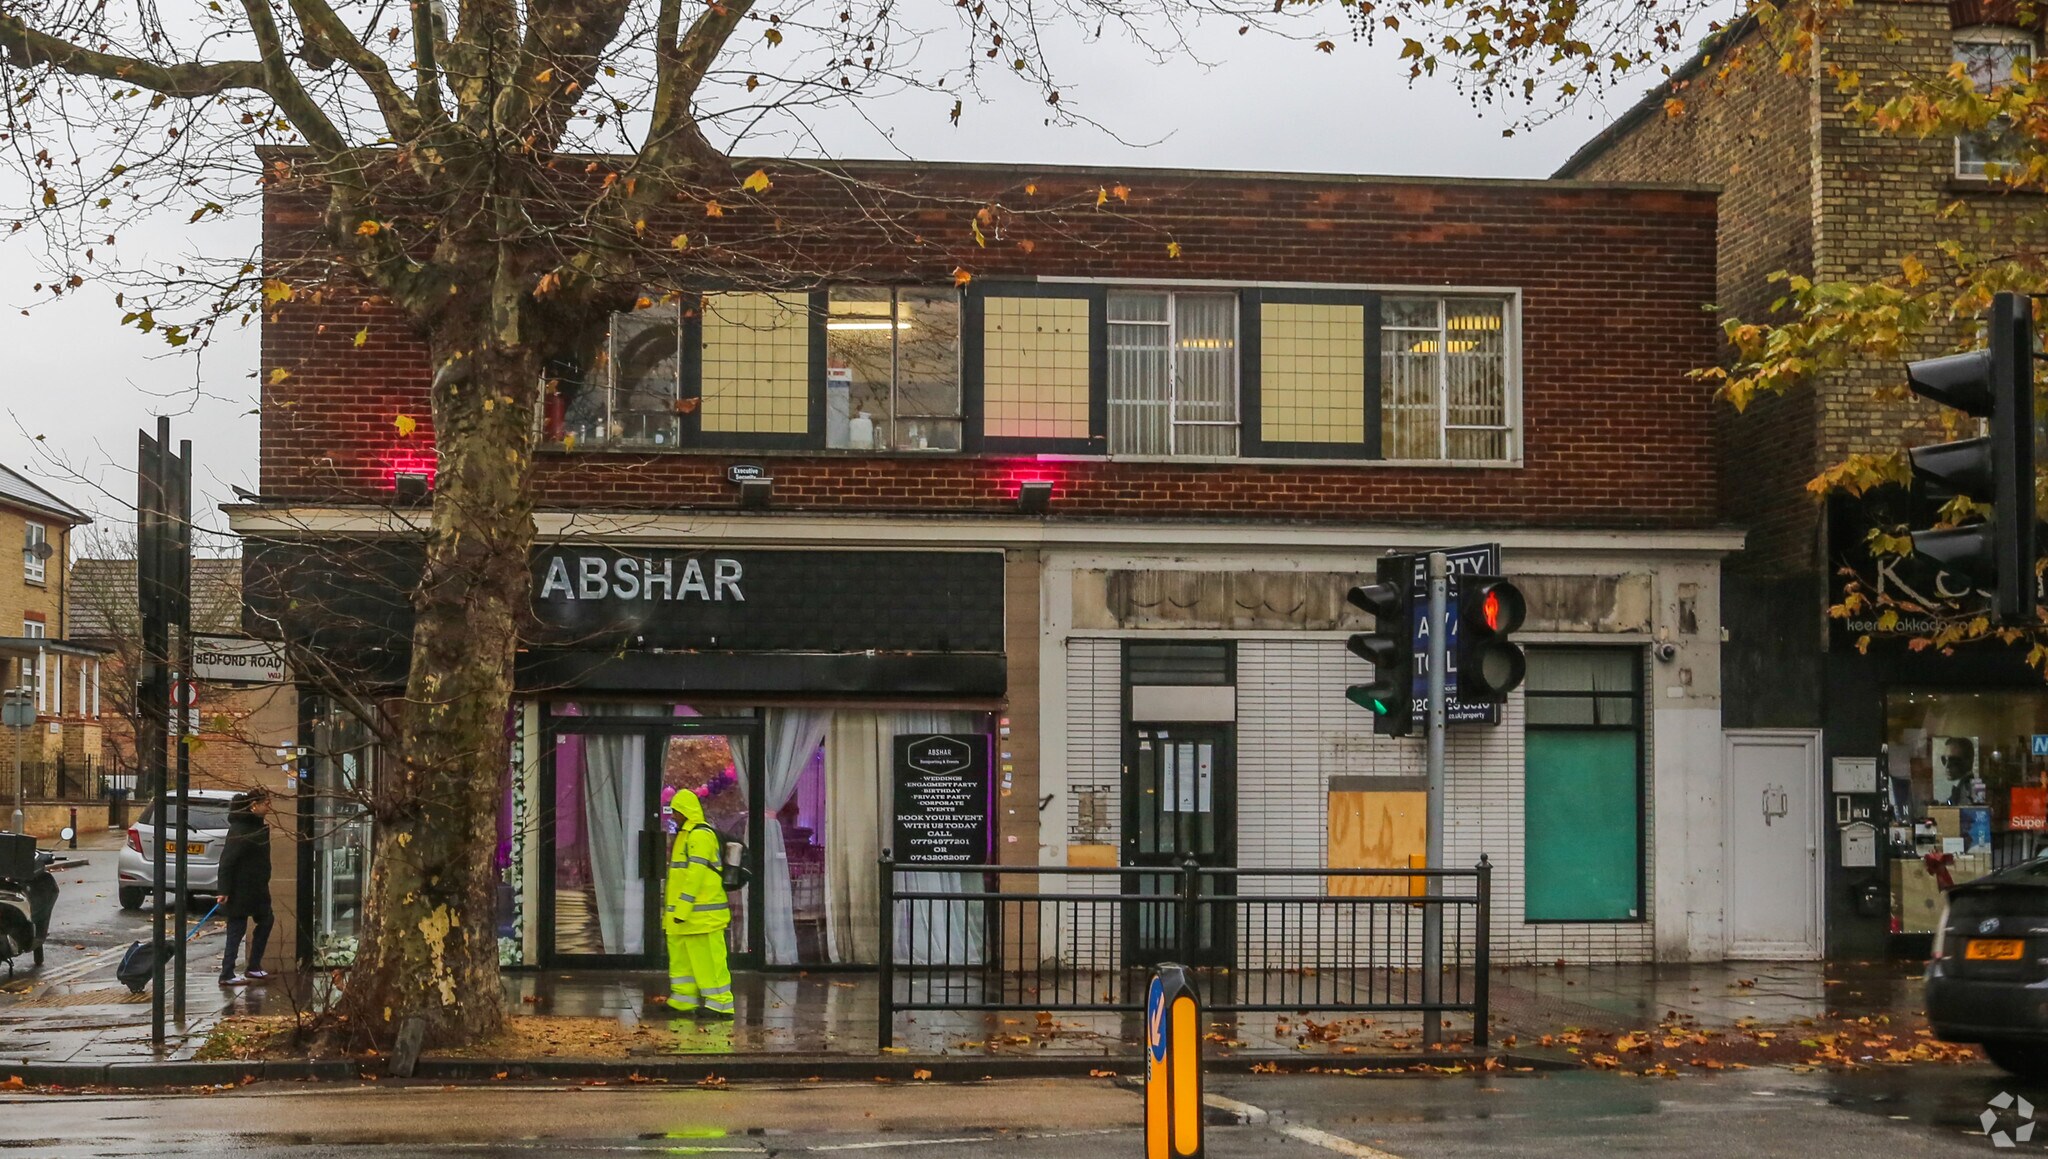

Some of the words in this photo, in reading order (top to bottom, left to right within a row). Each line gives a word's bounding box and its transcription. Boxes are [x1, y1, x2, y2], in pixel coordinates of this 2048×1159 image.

[733, 467, 759, 475] Executive
[540, 556, 746, 602] ABSHAR
[196, 652, 246, 667] BEDFORD
[250, 655, 282, 669] ROAD
[928, 748, 952, 756] ABSHAR
[2012, 816, 2046, 829] Super
